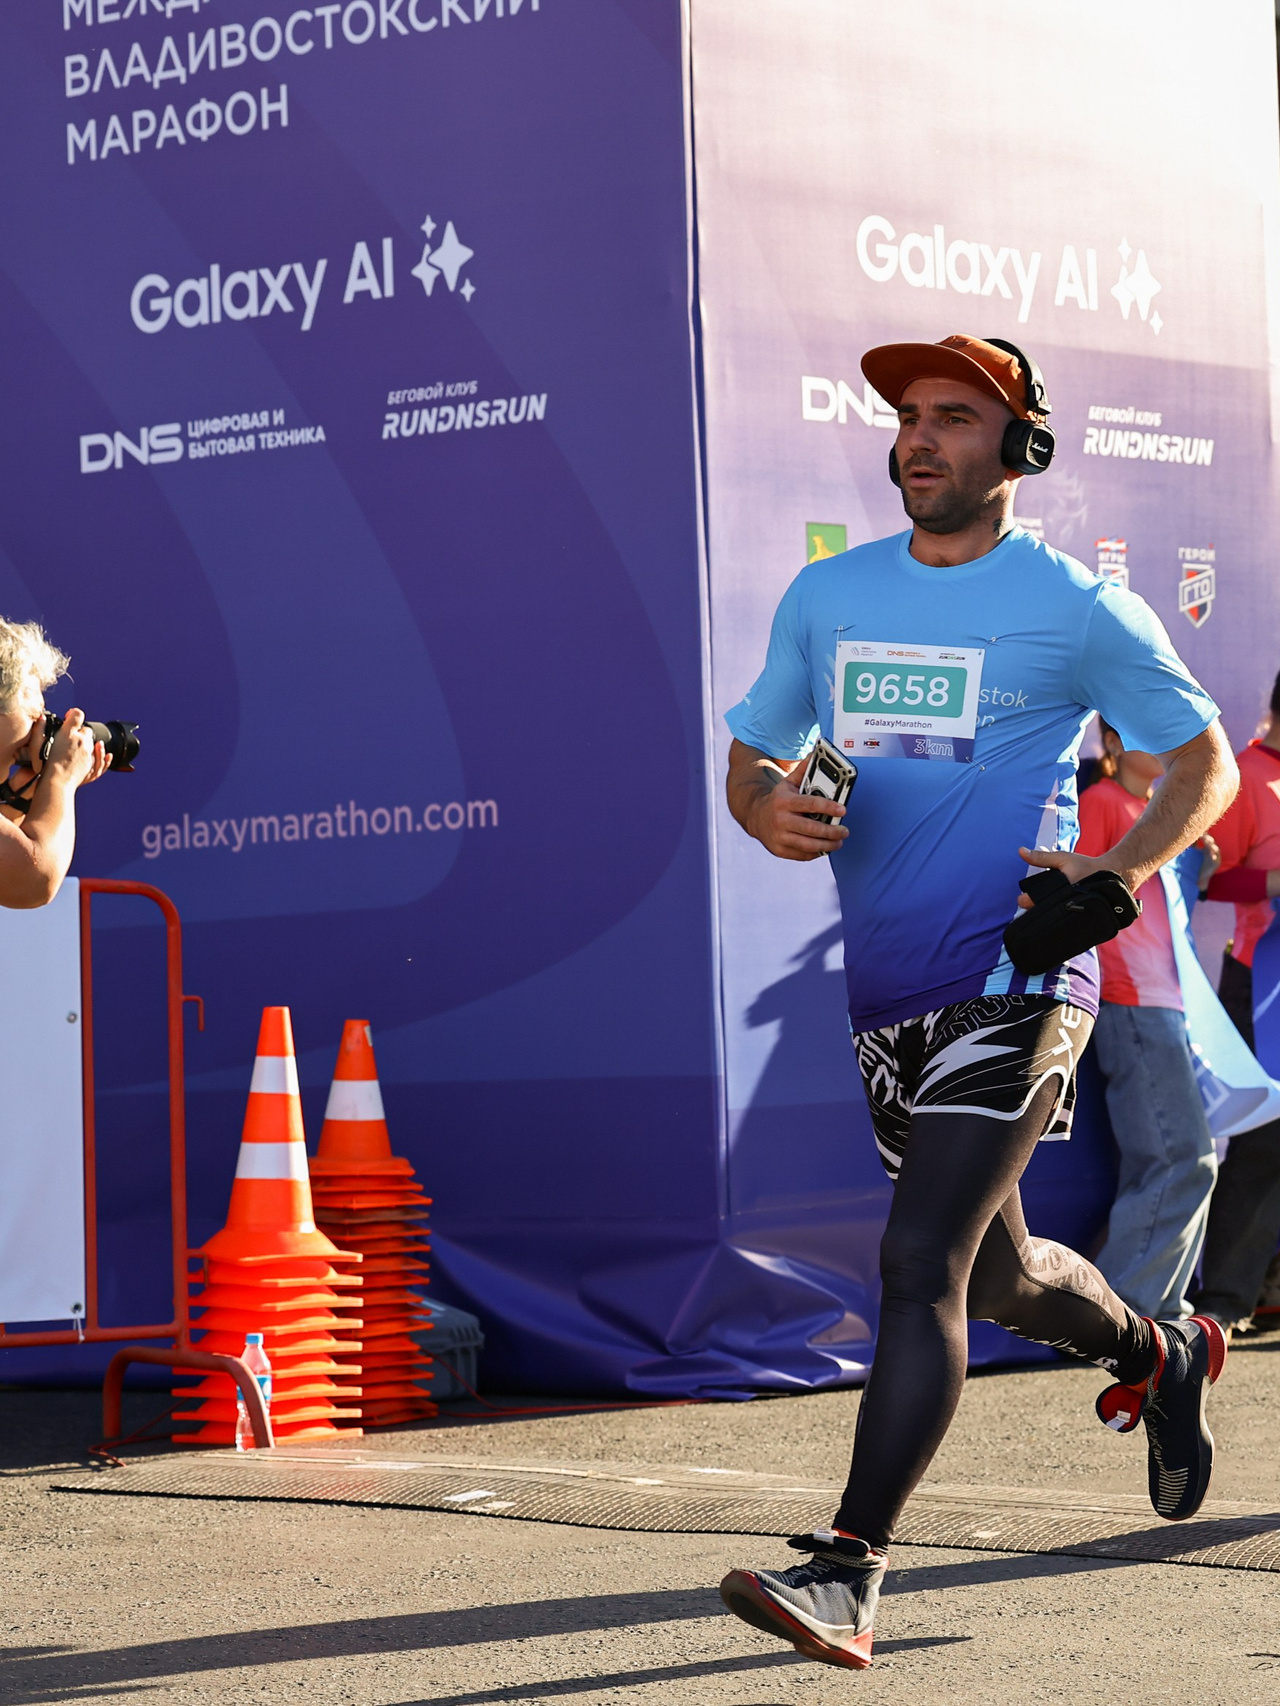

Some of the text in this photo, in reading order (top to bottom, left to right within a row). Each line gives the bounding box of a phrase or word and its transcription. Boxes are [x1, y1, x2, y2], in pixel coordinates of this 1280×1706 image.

[64, 0, 540, 98] ВЛАДИВОСТОКСК
[66, 83, 288, 165] МАРАФОН
[130, 237, 395, 334] Galaxy AI
[856, 214, 1099, 323] Galaxy AI
[387, 380, 478, 405] БЕГОВОЙ КЛУБ
[187, 408, 285, 438] ЦИФРОВАЯ И
[382, 393, 548, 440] RUNDNSRUN
[1088, 405, 1163, 427] БЕГОВОЙ КЛУБ
[79, 422, 184, 474] DNS
[188, 425, 326, 460] БЫТОВАЯ ТЕХНИКА
[1083, 427, 1214, 466] RUNDNSRUN
[1183, 578, 1211, 605] ГТО
[855, 672, 950, 706] 9658
[864, 718, 933, 730] #GalaxyMarathon
[913, 738, 954, 757] 3km
[141, 799, 500, 860] galaxymarathon.com
